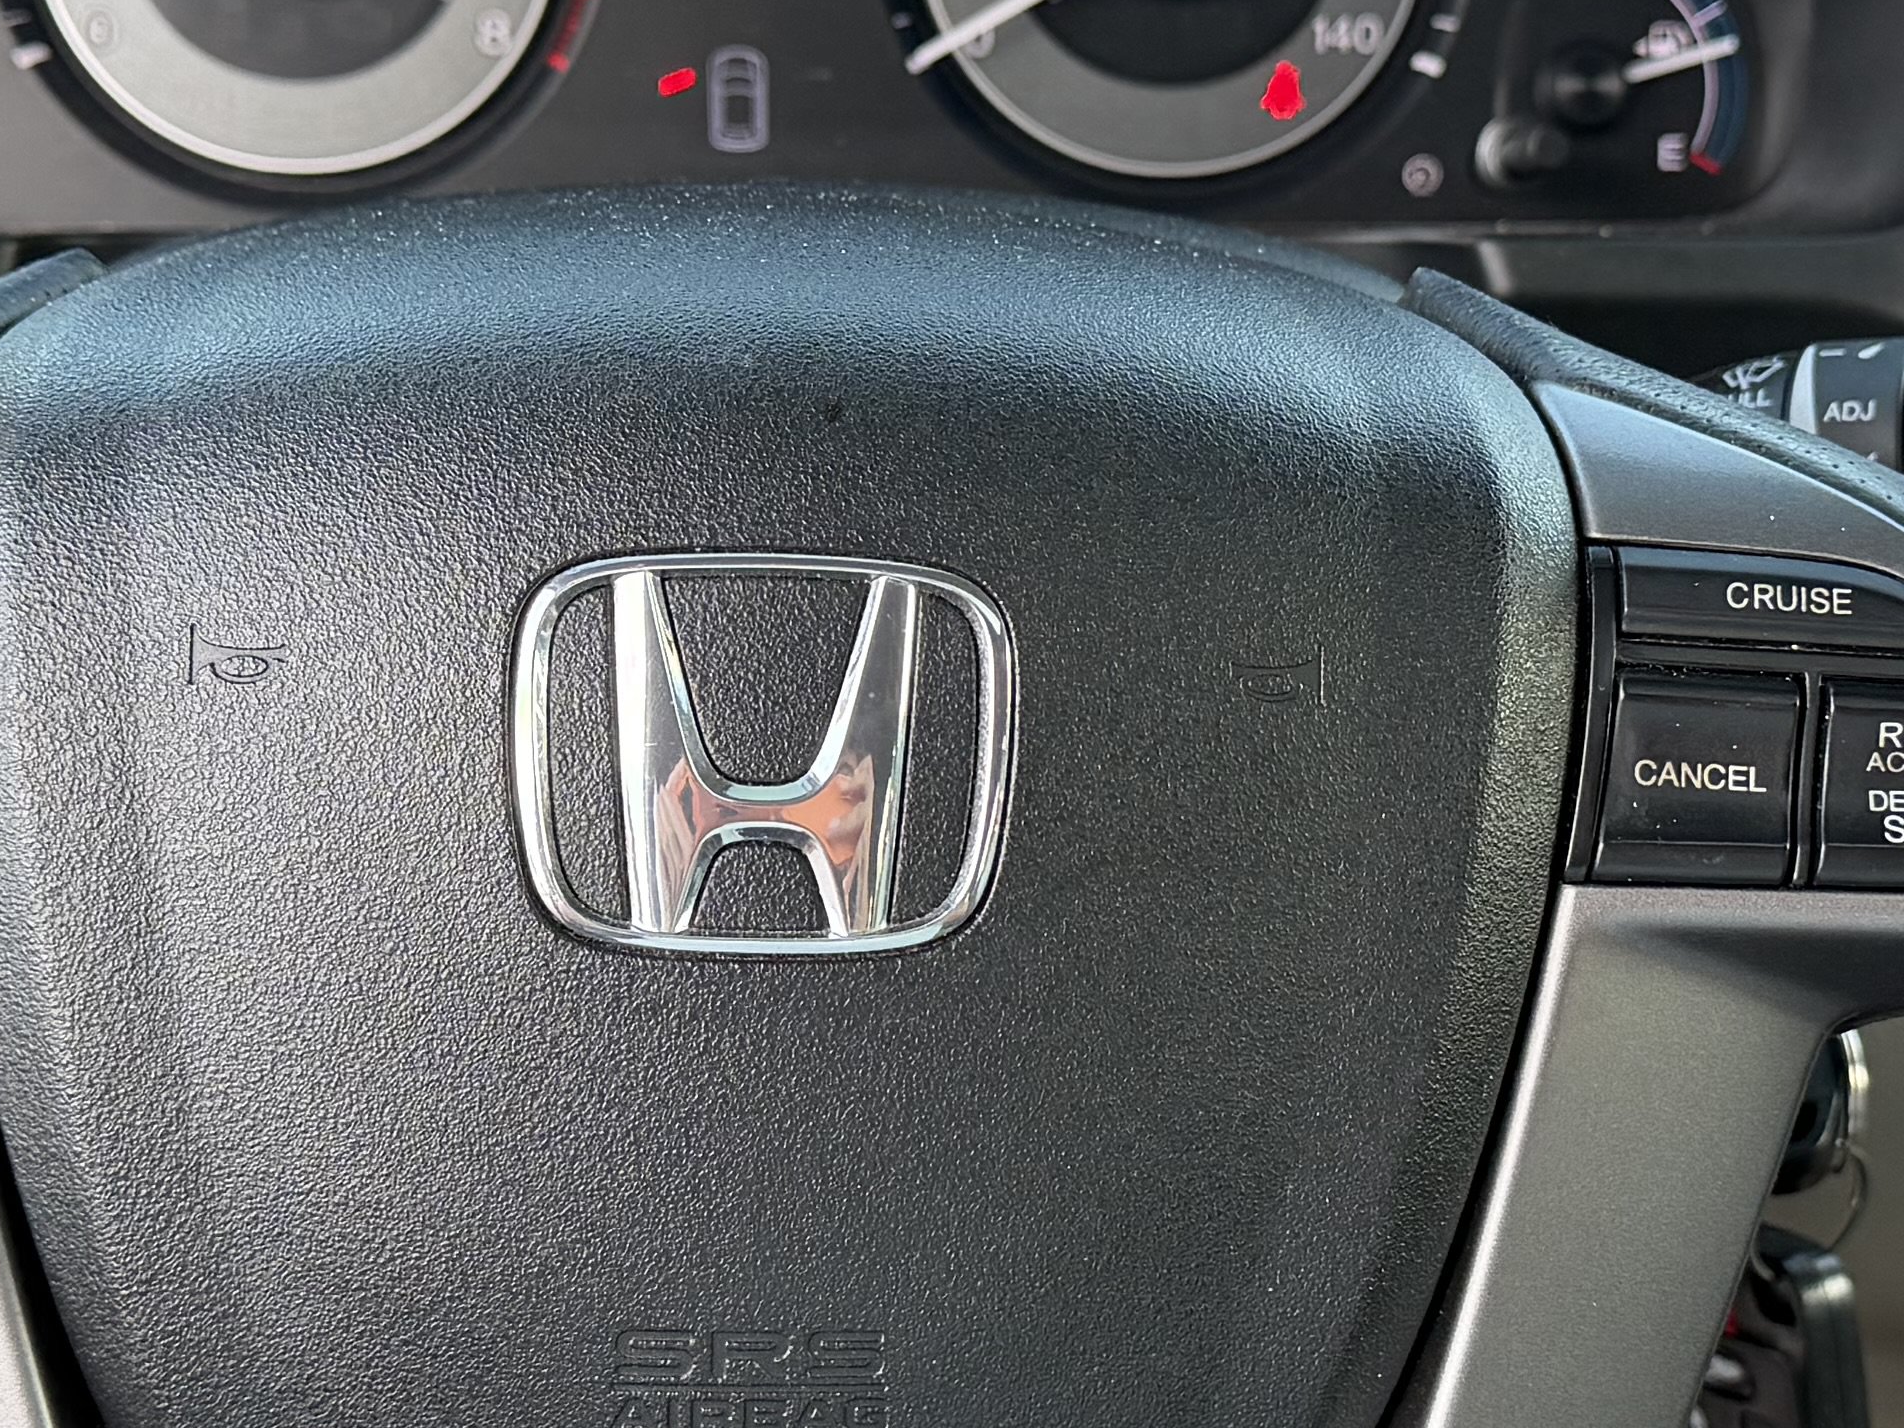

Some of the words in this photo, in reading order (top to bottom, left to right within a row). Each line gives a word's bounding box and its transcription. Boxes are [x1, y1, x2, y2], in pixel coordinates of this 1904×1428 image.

[472, 8, 515, 58] 8
[1311, 12, 1386, 55] 140
[1823, 398, 1877, 422] ADJ
[1725, 582, 1854, 616] CRUISE
[1633, 760, 1768, 794] CANCEL
